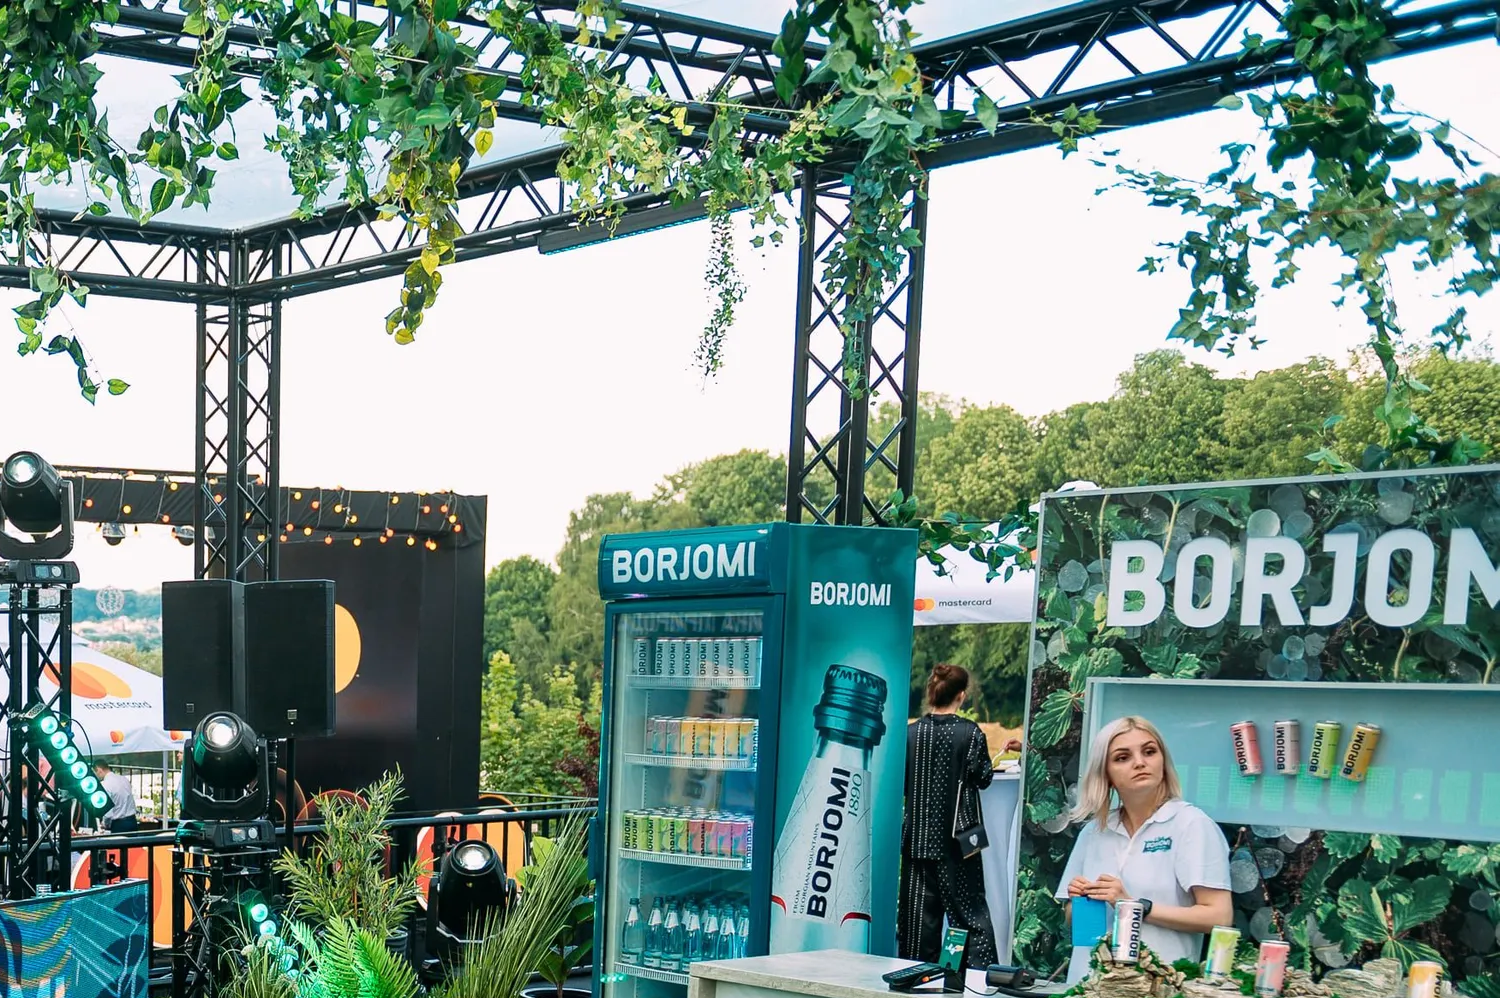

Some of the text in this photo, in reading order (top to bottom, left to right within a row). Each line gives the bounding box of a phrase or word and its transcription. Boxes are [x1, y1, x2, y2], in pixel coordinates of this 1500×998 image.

[612, 541, 756, 583] BORJOMI
[810, 581, 892, 606] BORJOMI
[938, 598, 992, 607] mastercard
[84, 701, 152, 711] mastercard
[1233, 728, 1248, 772] BORJOMI
[1276, 726, 1285, 771] BORJOMI
[1309, 728, 1324, 773] BORJOMI
[1342, 731, 1366, 775] BORJOMI
[847, 773, 862, 817] 1890
[806, 767, 851, 918] BORJOMI
[799, 823, 820, 915] GEORGIAN MOUNTAINS
[792, 889, 801, 914] FROM
[1129, 908, 1142, 958] BORJOMI
